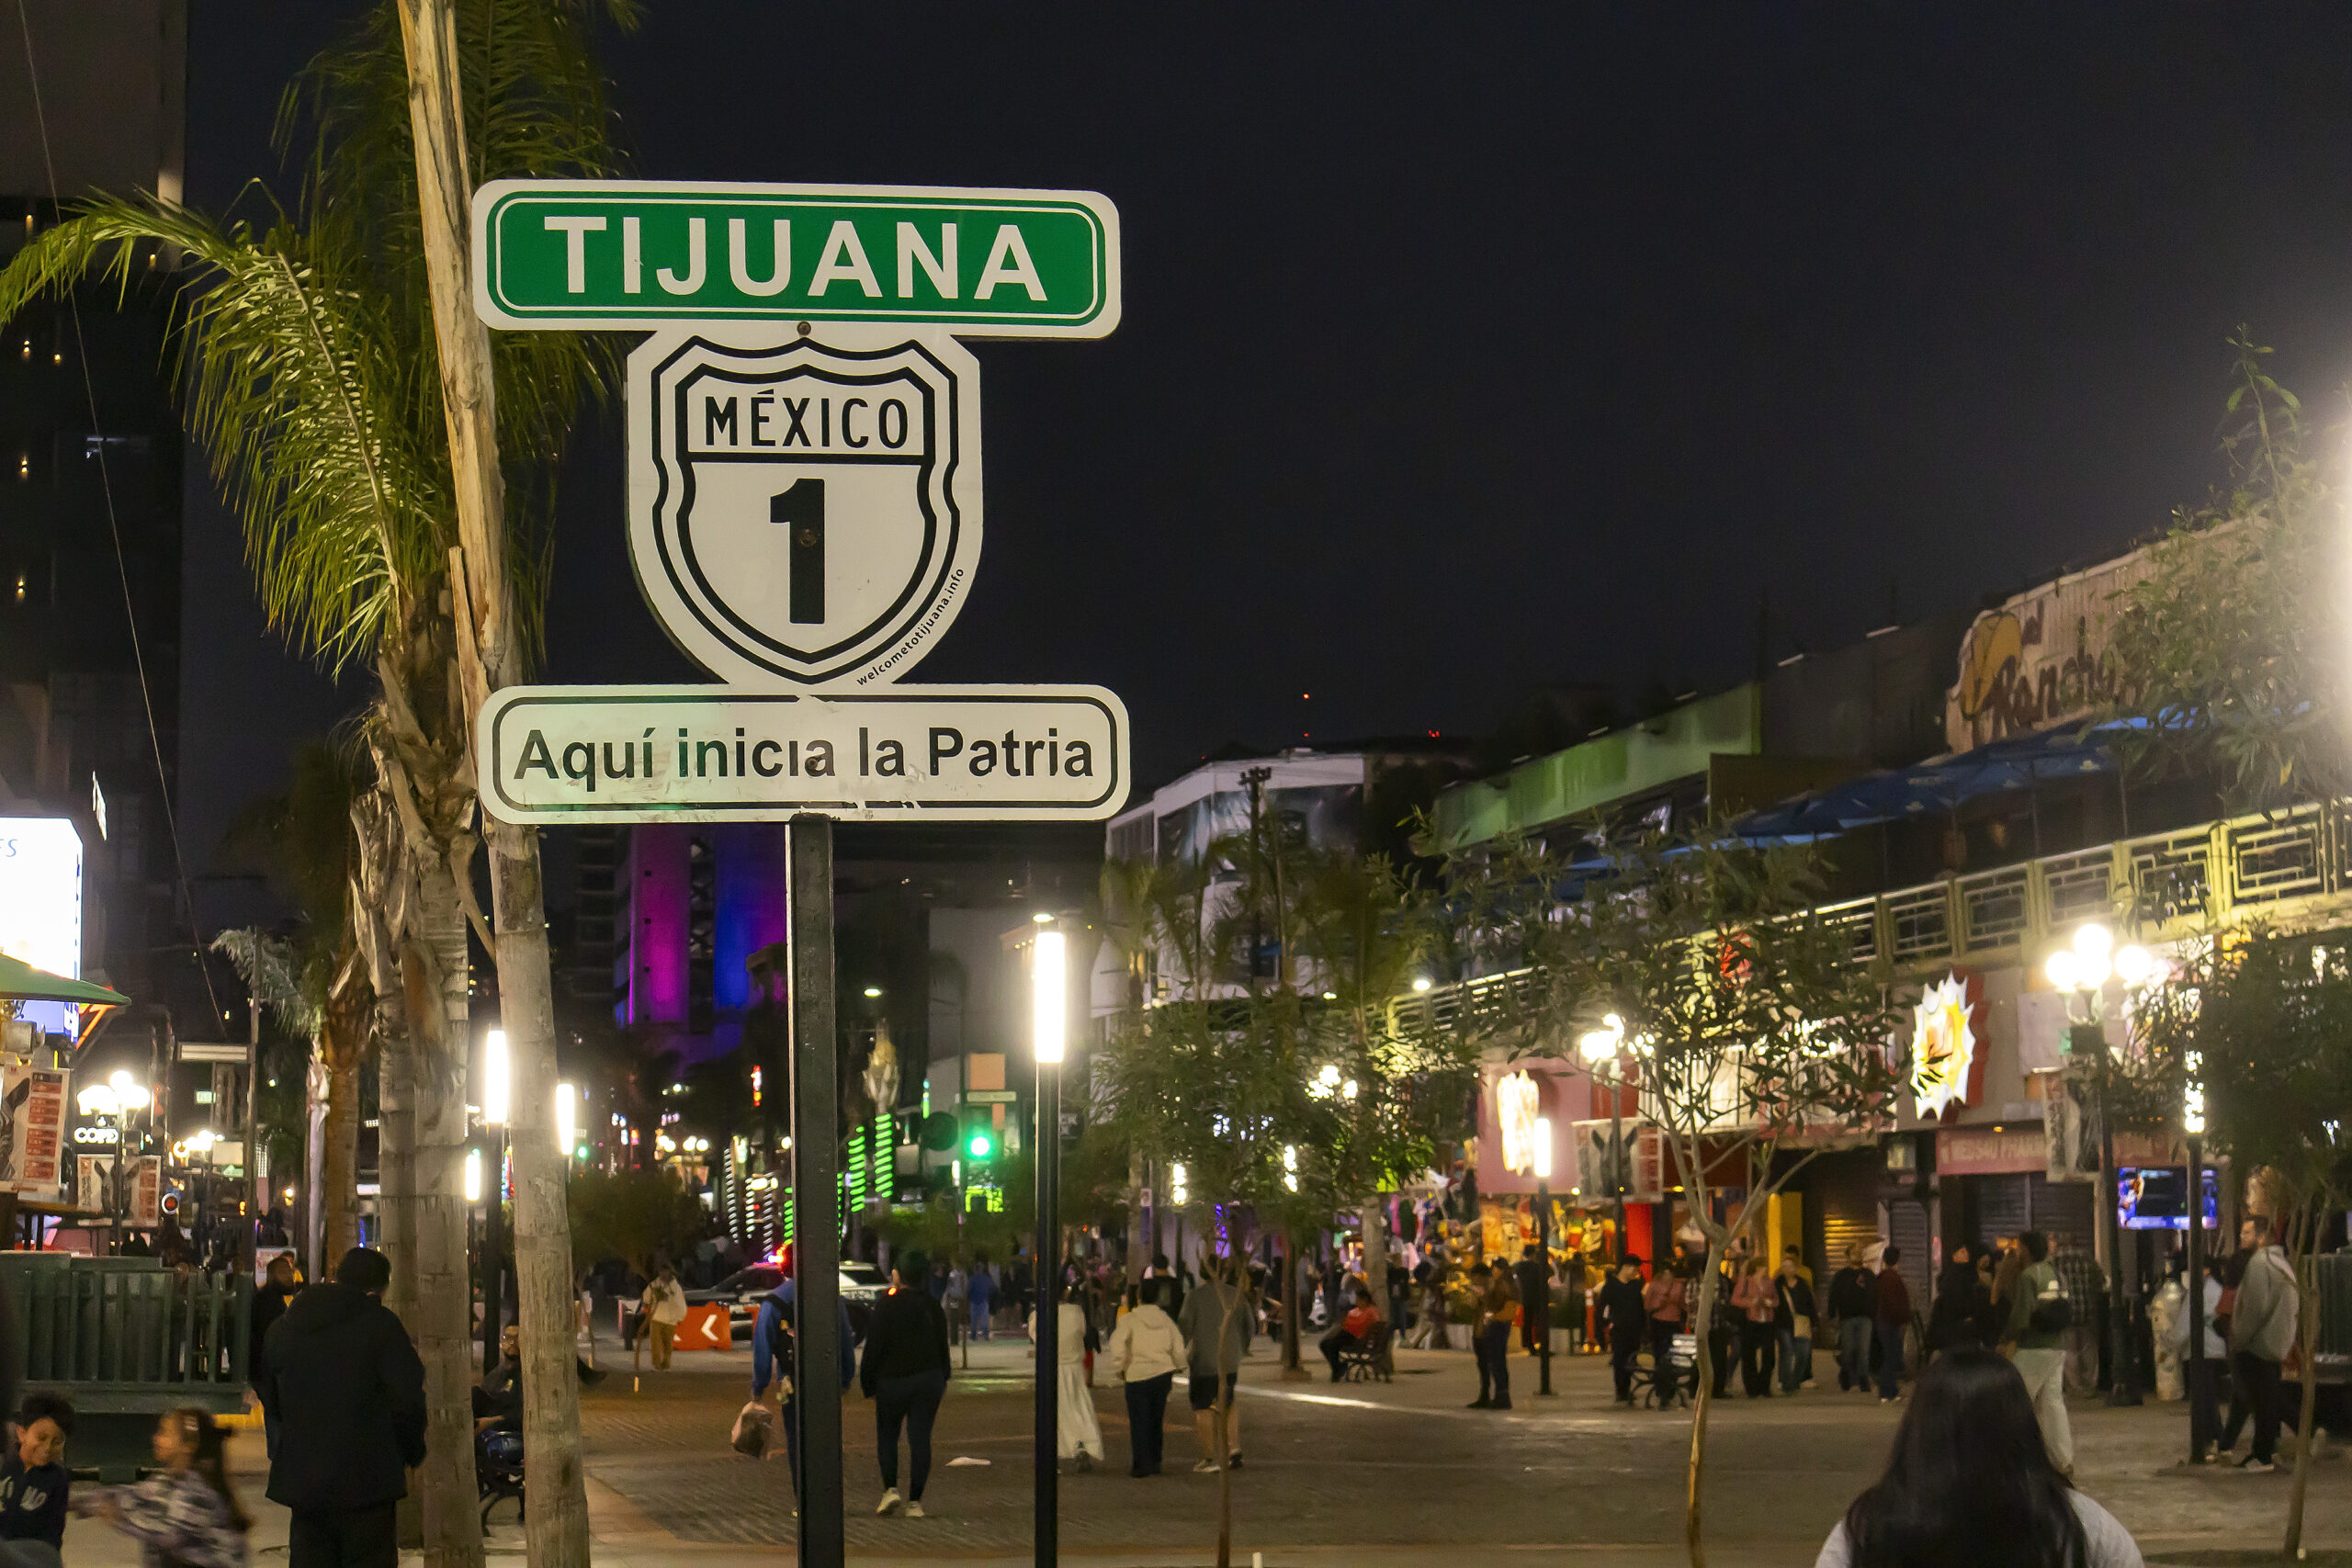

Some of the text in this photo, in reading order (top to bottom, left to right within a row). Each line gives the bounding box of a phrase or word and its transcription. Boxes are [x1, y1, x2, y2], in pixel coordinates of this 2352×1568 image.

[544, 216, 1048, 301] TIJUANA
[705, 389, 909, 449] MÉXICO
[768, 478, 826, 625] 1
[856, 568, 965, 686] welcometotijuana.info
[514, 727, 1093, 793] Aquí inicia la Patria
